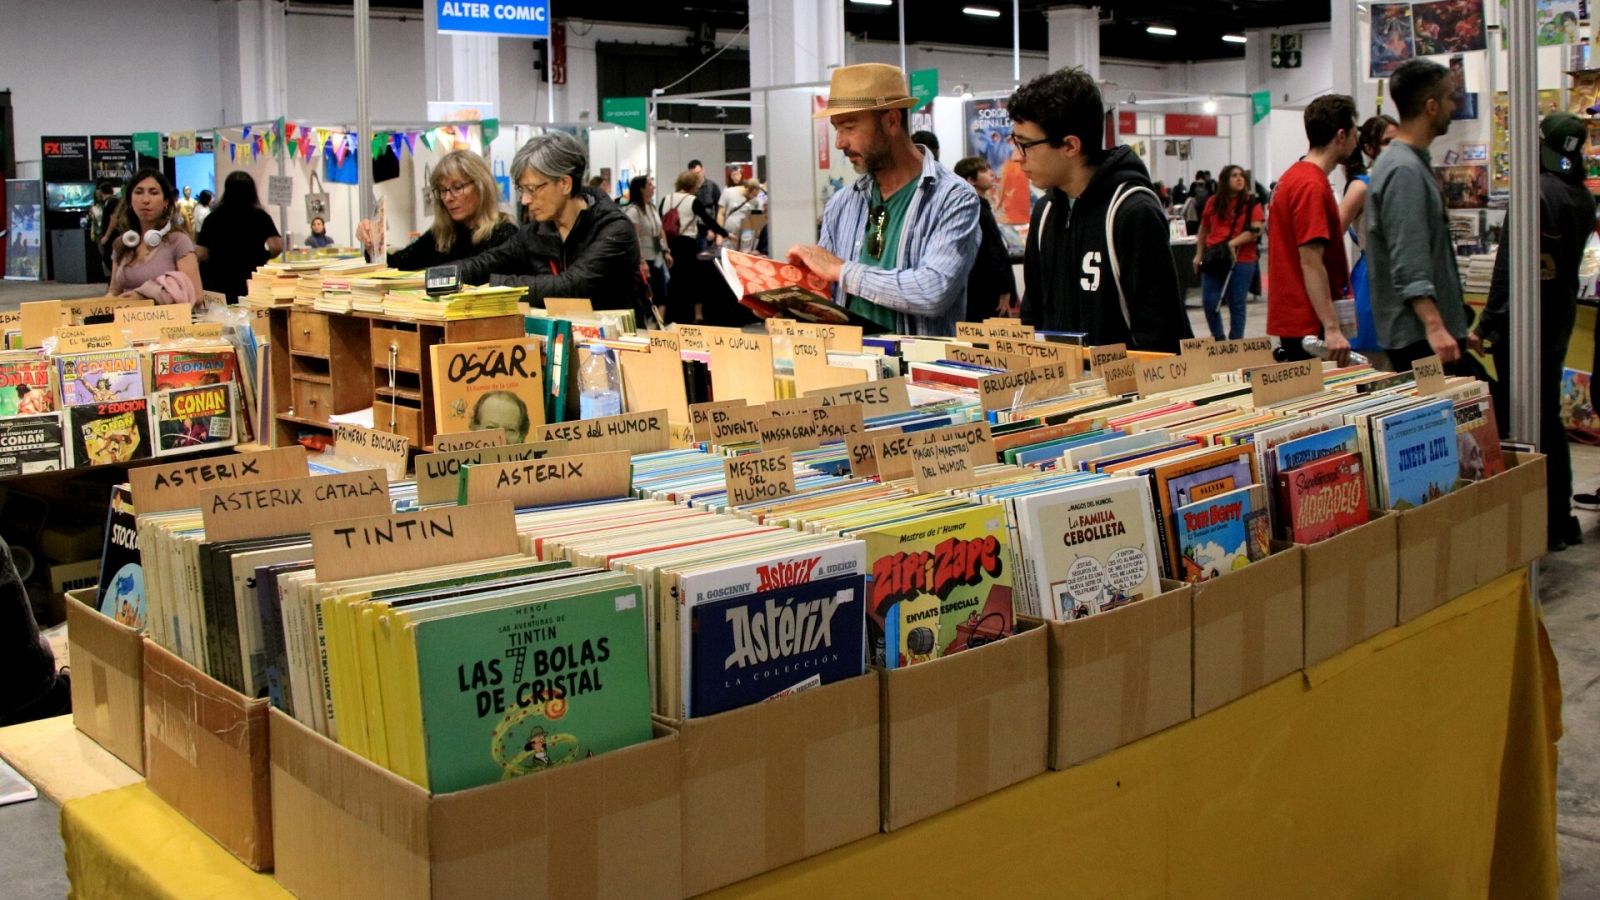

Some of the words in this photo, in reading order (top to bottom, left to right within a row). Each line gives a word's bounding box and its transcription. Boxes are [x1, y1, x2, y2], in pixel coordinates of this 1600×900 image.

[442, 1, 490, 18] ALTER
[494, 5, 545, 21] COMIC
[44, 143, 60, 154] FX
[94, 139, 108, 150] FX
[1080, 251, 1101, 291] S
[122, 310, 175, 323] NACIONAL
[958, 326, 984, 337] METAL
[715, 337, 724, 345] LA
[729, 338, 760, 350] CUPULA
[794, 345, 817, 356] OTROS
[996, 341, 1016, 353] BIB.
[1018, 343, 1059, 360] TOTEM
[78, 358, 137, 375] CONAN
[172, 361, 224, 373] CONAN
[952, 349, 1008, 369] TOUTAIN
[0, 371, 48, 386] ONAN
[1143, 366, 1165, 383] MAC
[1169, 362, 1187, 379] COY
[1262, 363, 1313, 386] BLUEBERRY
[174, 390, 225, 415] CONAN
[712, 412, 729, 423] ED.
[813, 409, 829, 420] ED.
[608, 417, 660, 435] HUMOR
[0, 433, 45, 446] CONAN
[339, 426, 366, 446] PRIMERAS
[371, 434, 406, 457] EDICIONES
[1398, 442, 1427, 472] JINETE
[1429, 436, 1449, 461] AZUL
[154, 459, 260, 490] ASTERIX
[497, 462, 584, 488] ASTERIX
[729, 455, 787, 478] MESTRES
[922, 466, 937, 478] DEL
[939, 459, 967, 474] HUMOR
[750, 475, 766, 486] DEL
[211, 488, 303, 514] ASTERIX
[315, 476, 384, 501] CATALÀ
[734, 481, 790, 502] HUMOR
[1297, 475, 1361, 529] MORTADELO
[1069, 517, 1079, 529] La
[1079, 510, 1115, 527] FAMILIA
[1184, 511, 1209, 531] Tom
[333, 514, 455, 549] TINTIN
[900, 531, 925, 544] Mestres
[927, 528, 935, 537] de
[1063, 521, 1126, 546] CEBOLLETA
[697, 593, 705, 601] R.
[706, 583, 751, 599] GOSCINNY
[756, 556, 822, 593] Astérix
[827, 560, 857, 574] UDERZO
[906, 607, 938, 624] ENVIATS
[941, 596, 979, 615] ESPECIALS
[514, 617, 553, 630] AVENTURAS
[725, 587, 854, 671] Astérix
[319, 635, 326, 646] DE
[509, 626, 557, 647] TINTIN
[320, 649, 332, 700] AVENTURES
[458, 659, 502, 692] LAS
[505, 647, 527, 684] 7
[534, 637, 611, 675] BOLAS
[725, 680, 741, 688] LA
[754, 654, 838, 681] COLECCIÓN
[476, 688, 505, 719] DE
[516, 667, 603, 709] CRISTAL
